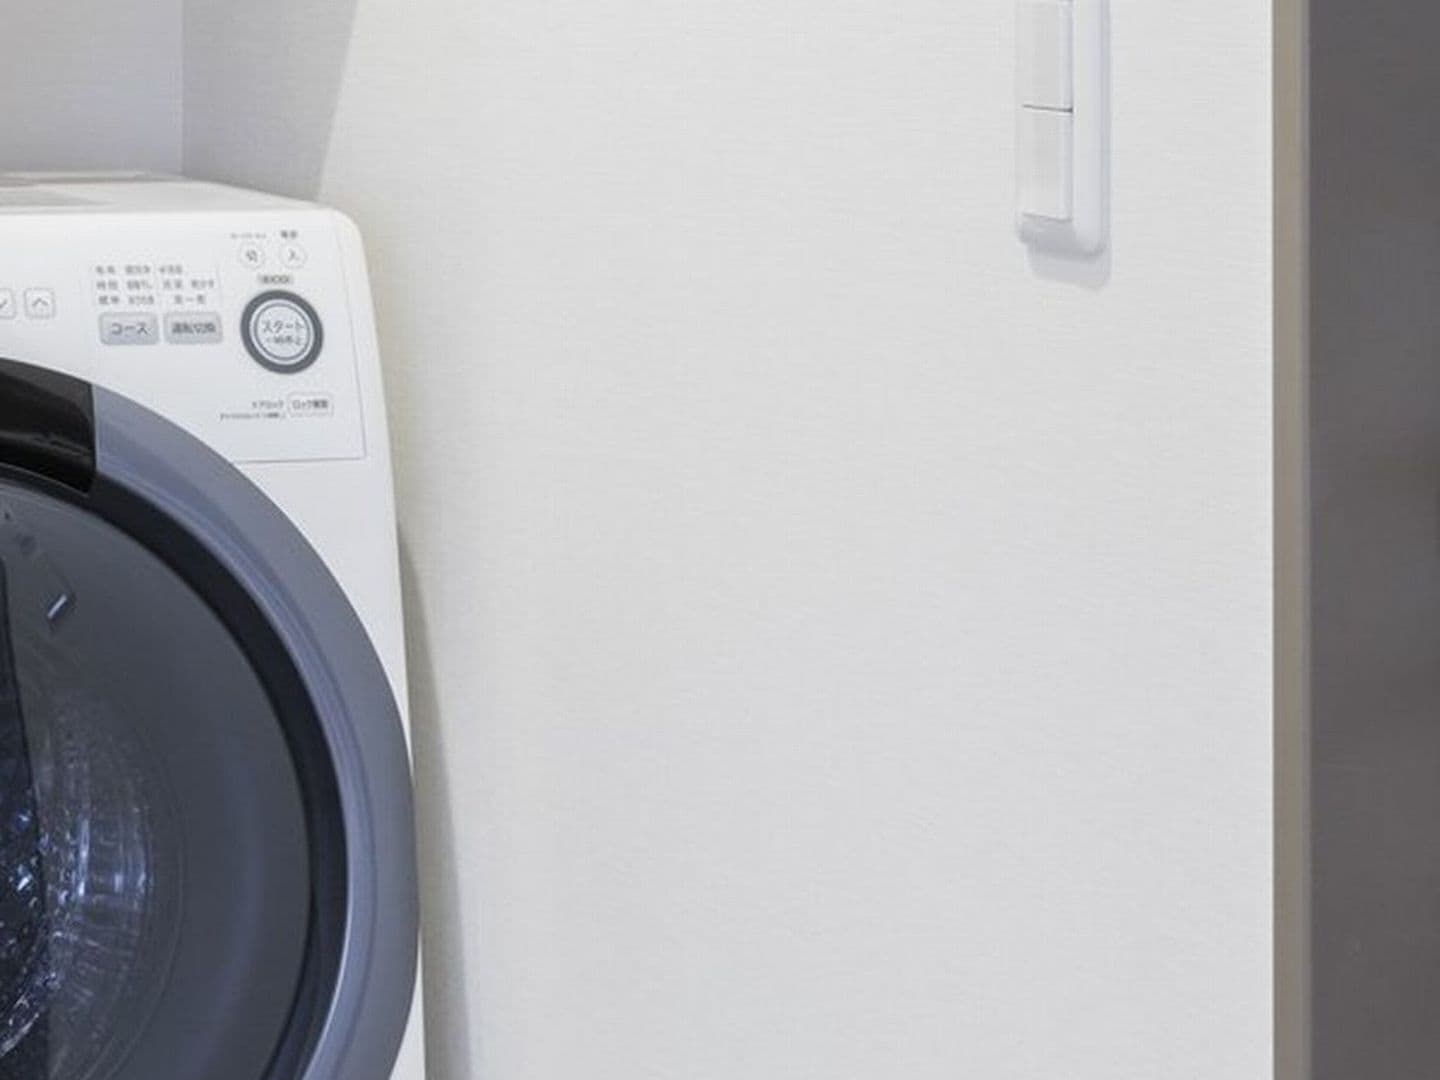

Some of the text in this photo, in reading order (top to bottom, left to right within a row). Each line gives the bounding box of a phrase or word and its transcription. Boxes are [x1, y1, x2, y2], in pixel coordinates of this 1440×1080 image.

[111, 322, 149, 335] コース
[262, 319, 305, 334] スタート
